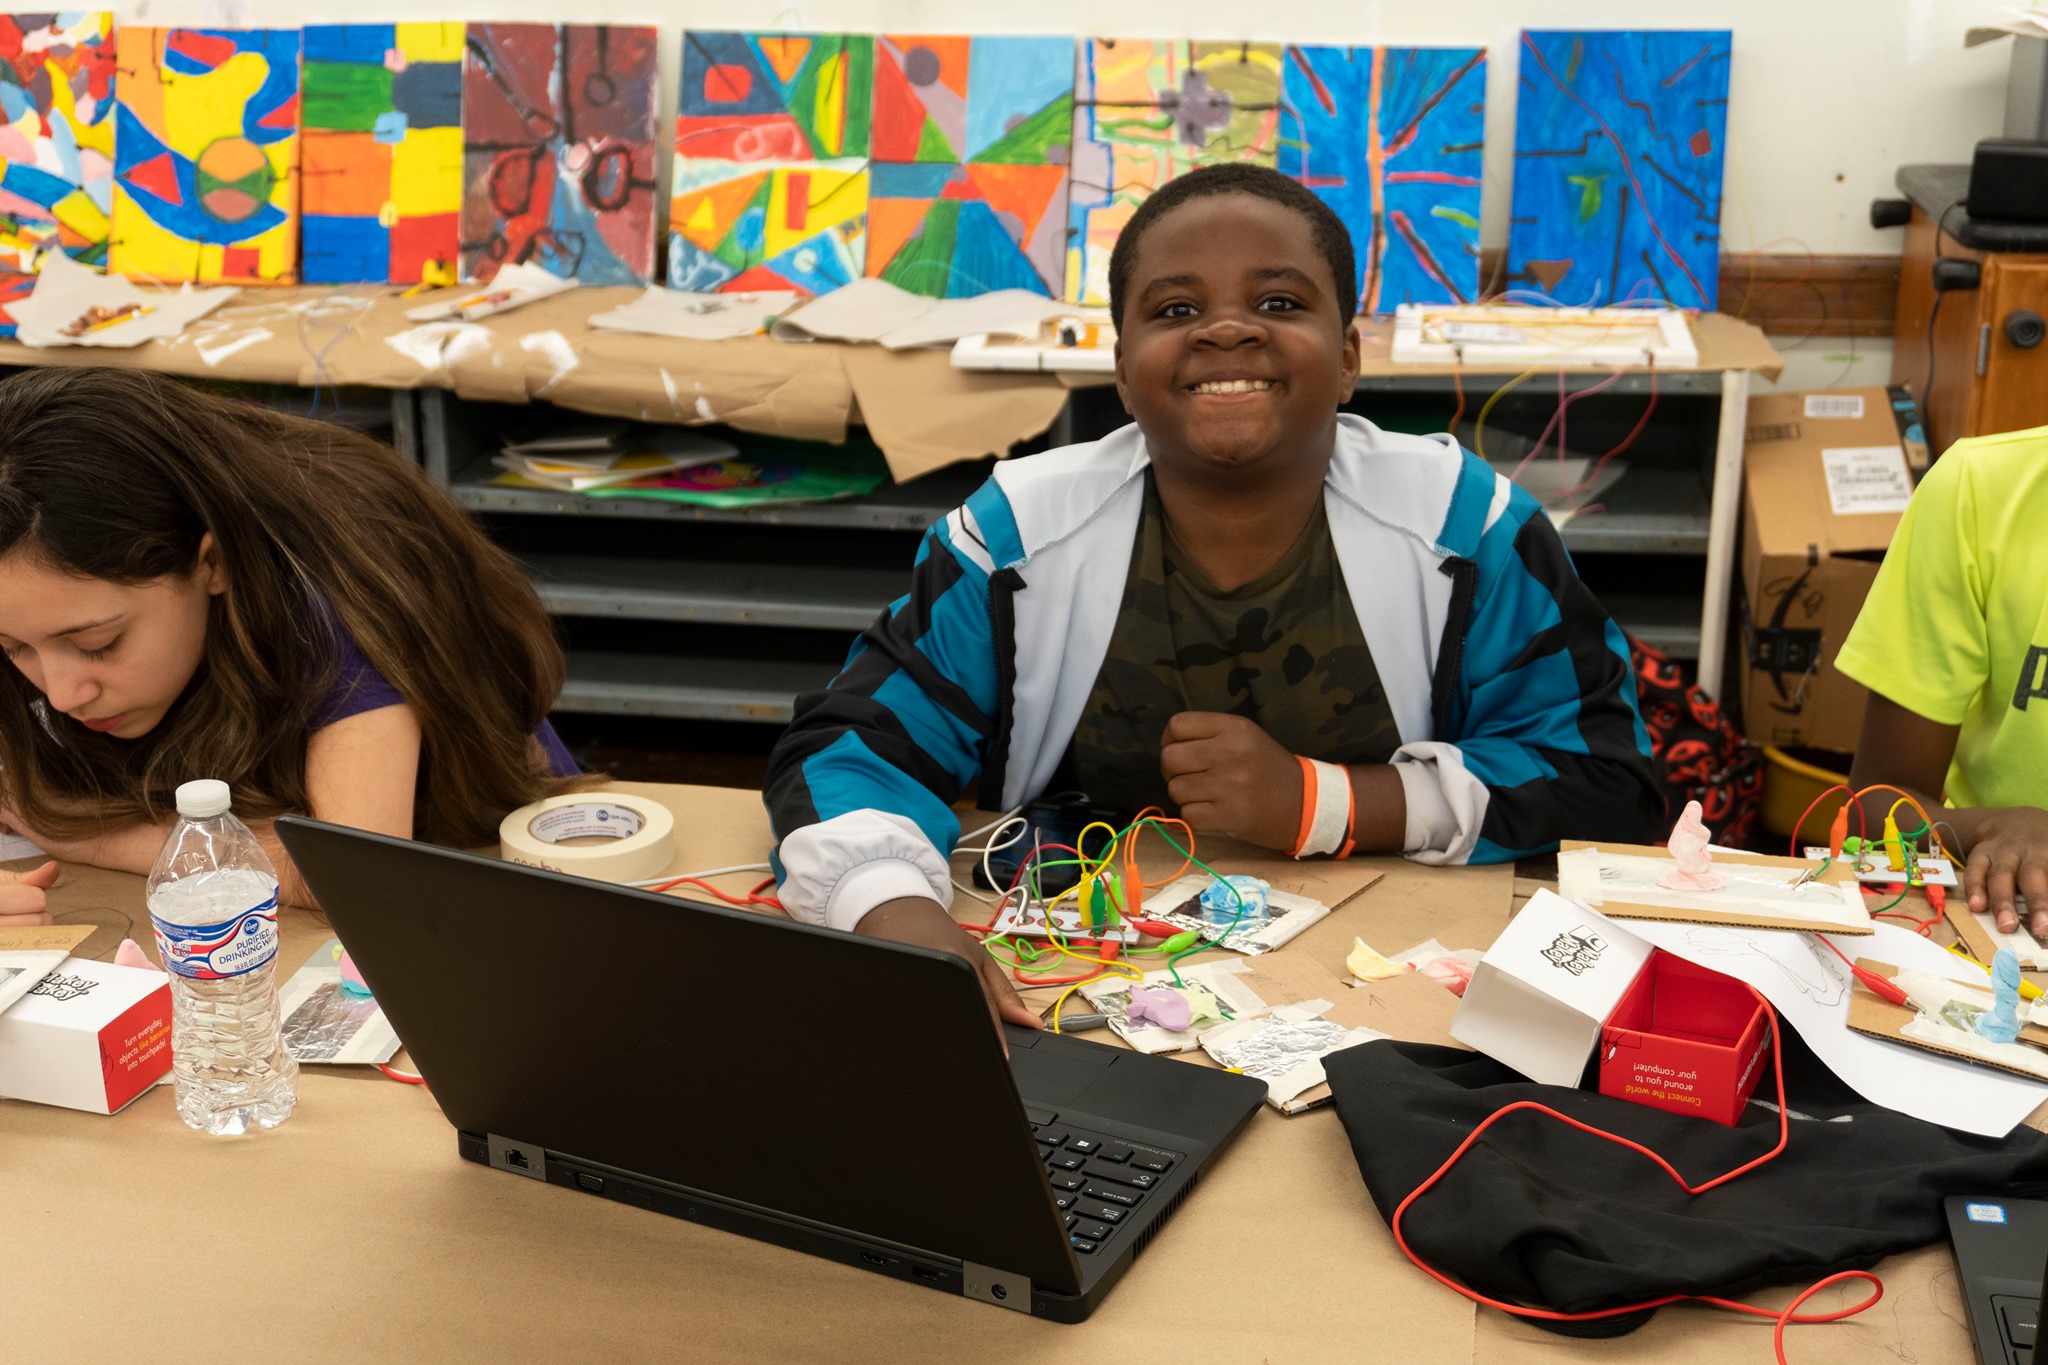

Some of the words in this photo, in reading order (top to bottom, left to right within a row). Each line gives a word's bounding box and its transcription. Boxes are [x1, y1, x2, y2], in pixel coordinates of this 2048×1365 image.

[236, 928, 270, 950] PURIFIED
[219, 942, 262, 965] DRINKING
[1561, 945, 1602, 977] Makey
[124, 1036, 137, 1048] Turn
[137, 1018, 163, 1039] everyday
[119, 1047, 139, 1065] objects
[138, 1039, 149, 1051] like
[149, 1024, 171, 1043] bananas
[127, 1060, 139, 1071] into
[138, 1037, 166, 1063] touchpads!
[1633, 1062, 1675, 1076] computer!
[1635, 1074, 1643, 1083] to
[1646, 1076, 1662, 1085] you
[1677, 1071, 1697, 1080] your
[1625, 1084, 1650, 1095] world
[1663, 1080, 1694, 1091] around
[1651, 1089, 1665, 1100] the
[1667, 1092, 1701, 1107] Connect
[1127, 1142, 1160, 1156] Precision
[1160, 1150, 1176, 1158] Dell
[1132, 1178, 1147, 1186] Shift
[1102, 1191, 1117, 1199] Lock
[1116, 1194, 1132, 1202] Caps
[1056, 1198, 1066, 1207] Q
